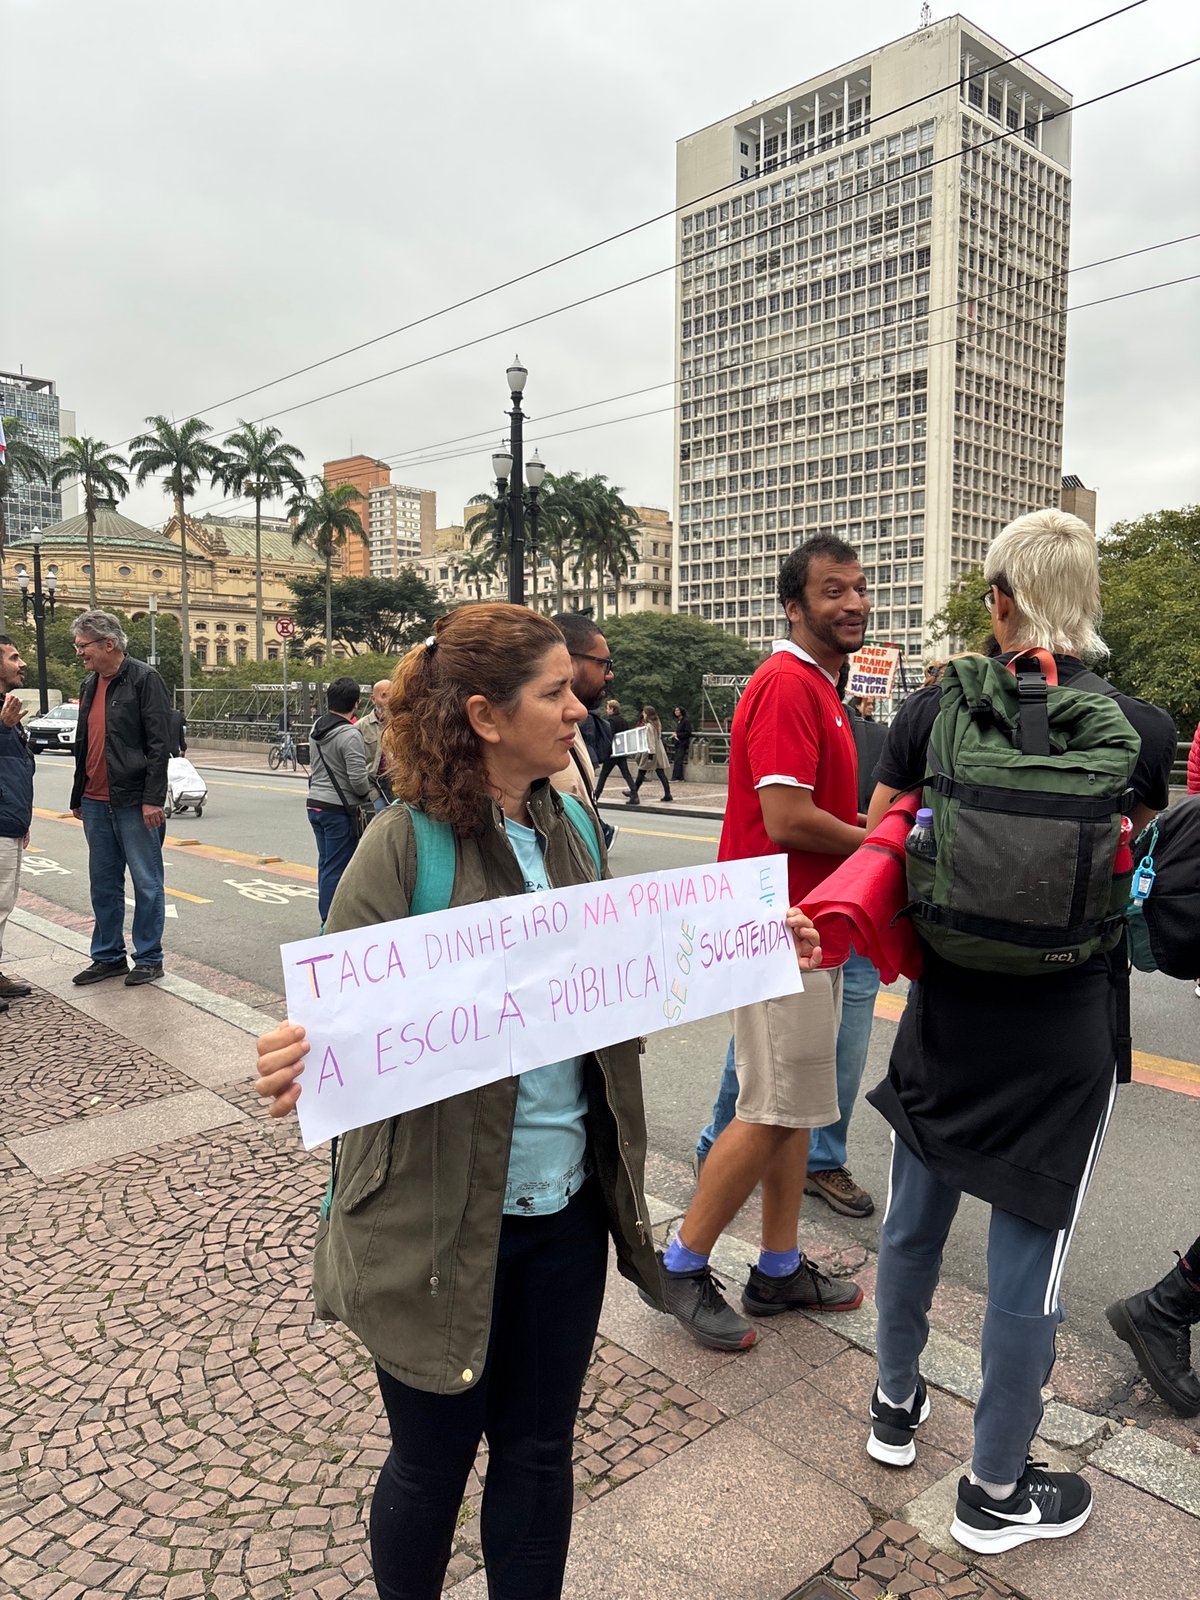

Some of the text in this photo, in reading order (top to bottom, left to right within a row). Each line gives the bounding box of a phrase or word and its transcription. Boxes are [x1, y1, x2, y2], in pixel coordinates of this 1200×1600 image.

[862, 648, 886, 656] EMEF
[854, 656, 892, 668] IBRAHIM
[860, 666, 889, 675] NOBRE
[852, 674, 888, 685] SEMPRE
[851, 684, 886, 694] NA LUTA
[296, 940, 406, 998] TACA
[424, 901, 568, 970] DINHEIRO
[584, 893, 620, 929] NA
[628, 872, 734, 918] PRIVADA
[318, 1045, 344, 1094] A
[376, 991, 526, 1075] ESCOLA
[548, 954, 660, 1022] PÚBLICA
[700, 920, 792, 969] SUCATEADA
